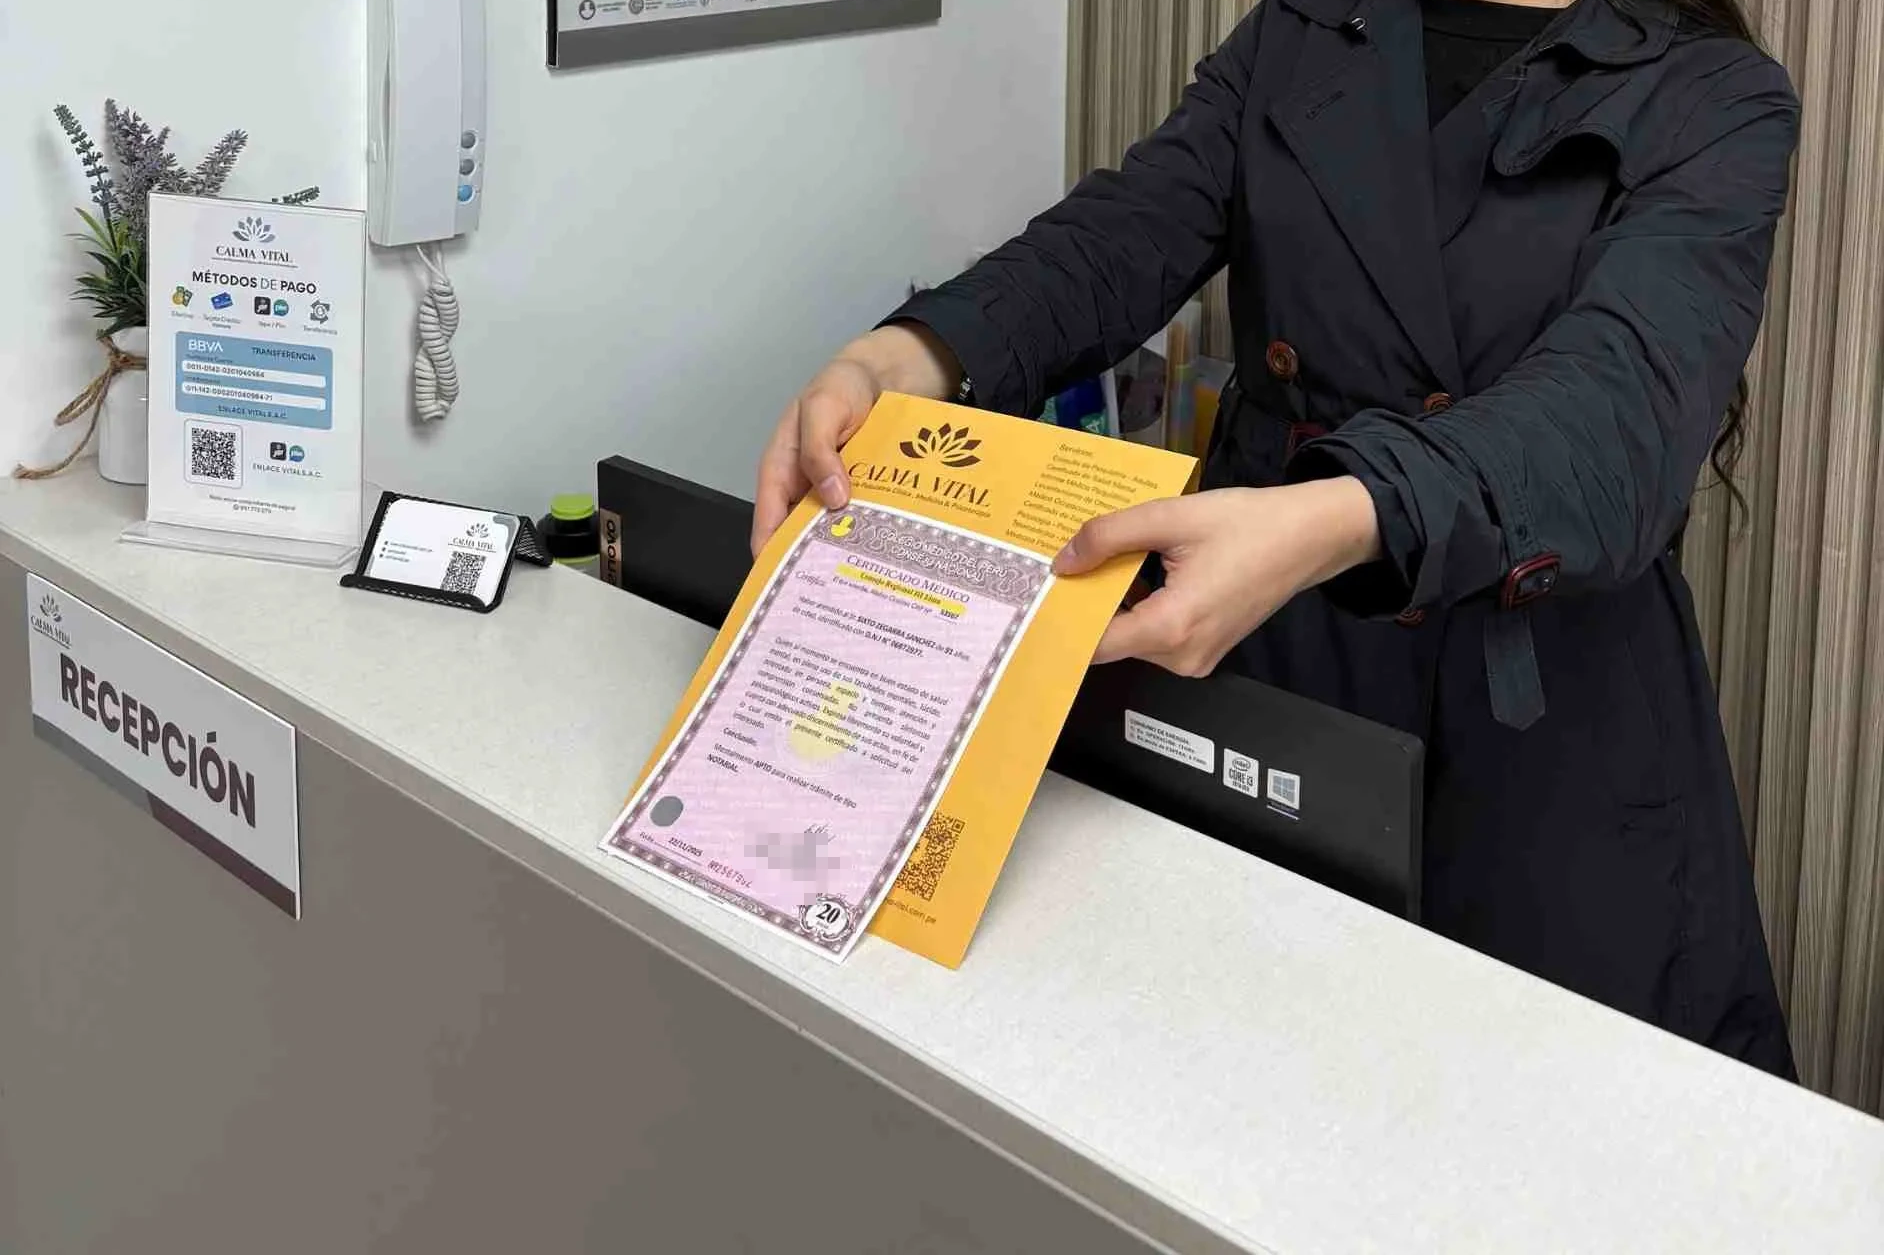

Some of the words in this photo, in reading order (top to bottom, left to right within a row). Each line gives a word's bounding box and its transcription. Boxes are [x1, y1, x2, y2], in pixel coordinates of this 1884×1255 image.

[216, 245, 256, 259] CALMA
[262, 249, 293, 263] VITAL
[192, 270, 257, 289] MÉTODOS
[260, 278, 278, 290] DE
[280, 280, 317, 294] PAGO
[189, 339, 224, 352] BBVA
[252, 346, 316, 361] TRANSFERENCIA
[218, 405, 245, 416] ENLACE
[253, 463, 281, 473] ENLACE
[848, 462, 920, 489] CALMA
[933, 476, 992, 507] VITAL
[843, 554, 924, 587] CERTIFICADO
[60, 652, 256, 828] RECEPCIÓN
[1229, 768, 1245, 783] CORE
[818, 903, 840, 924] 20
